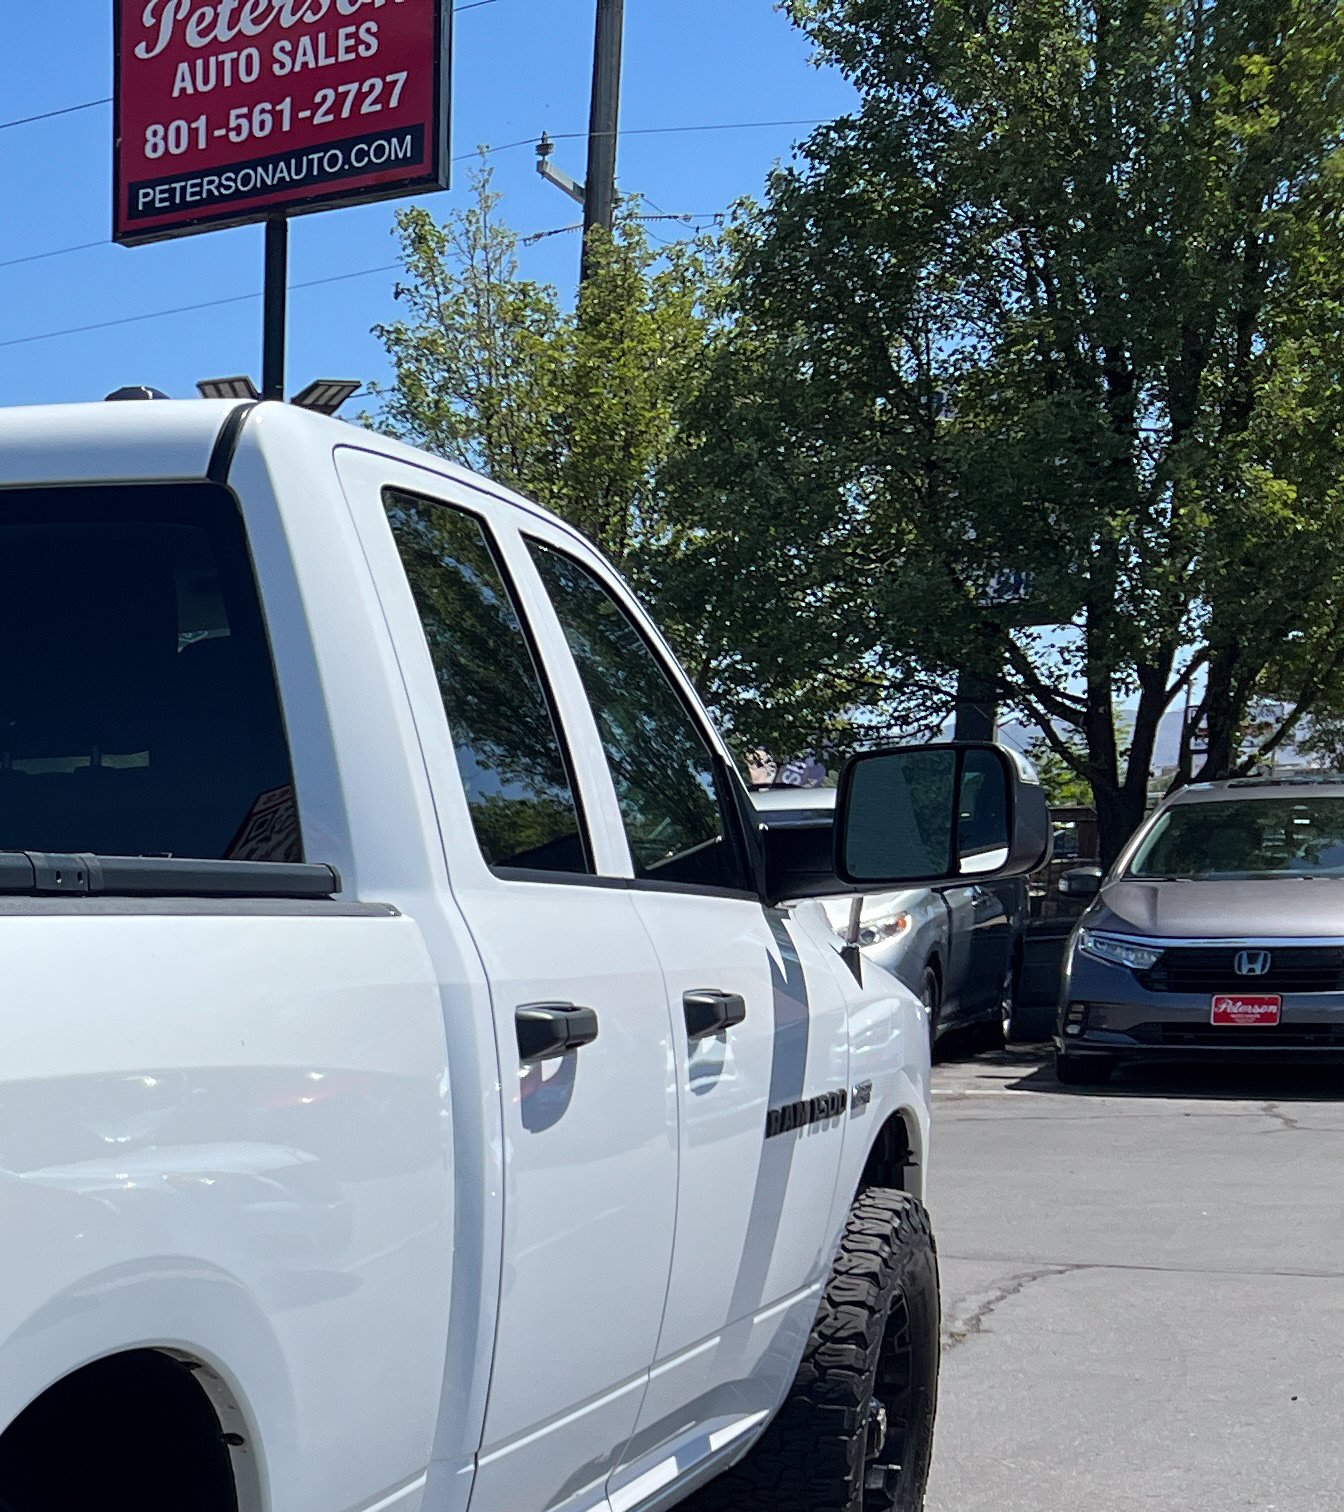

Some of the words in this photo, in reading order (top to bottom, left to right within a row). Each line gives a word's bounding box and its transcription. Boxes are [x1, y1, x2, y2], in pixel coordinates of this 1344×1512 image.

[171, 46, 261, 98] AUTO
[272, 21, 379, 76] SALES
[143, 71, 409, 159] 801-561-2727
[137, 135, 413, 210] PETERSONAUTO.COM
[1215, 998, 1278, 1014] Peterson
[765, 1100, 810, 1139] RAM
[808, 1088, 848, 1123] 1500
